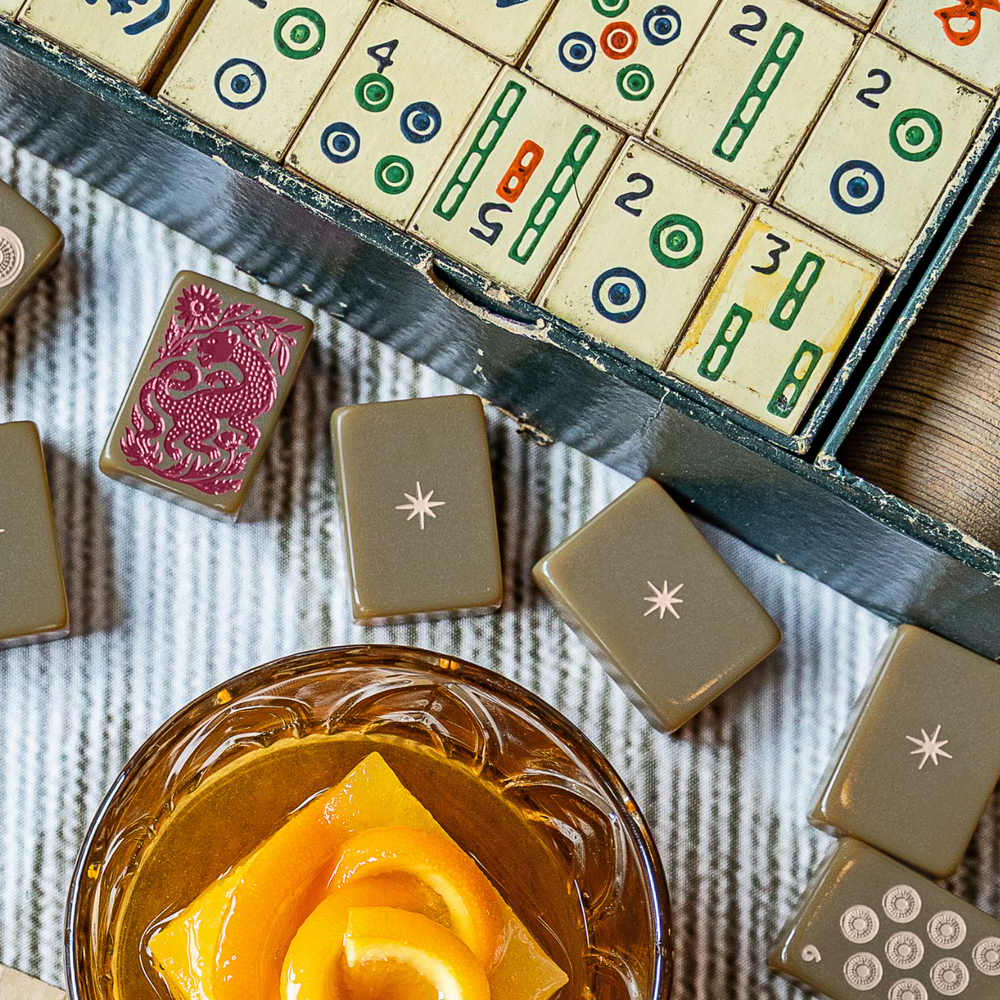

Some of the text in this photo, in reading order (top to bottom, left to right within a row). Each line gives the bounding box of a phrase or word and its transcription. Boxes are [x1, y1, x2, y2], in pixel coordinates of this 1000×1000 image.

[728, 5, 768, 46] 2
[366, 38, 400, 75] 4
[856, 68, 892, 109] 2
[614, 171, 654, 217] 2
[469, 201, 514, 247] 5
[751, 233, 791, 275] 3
